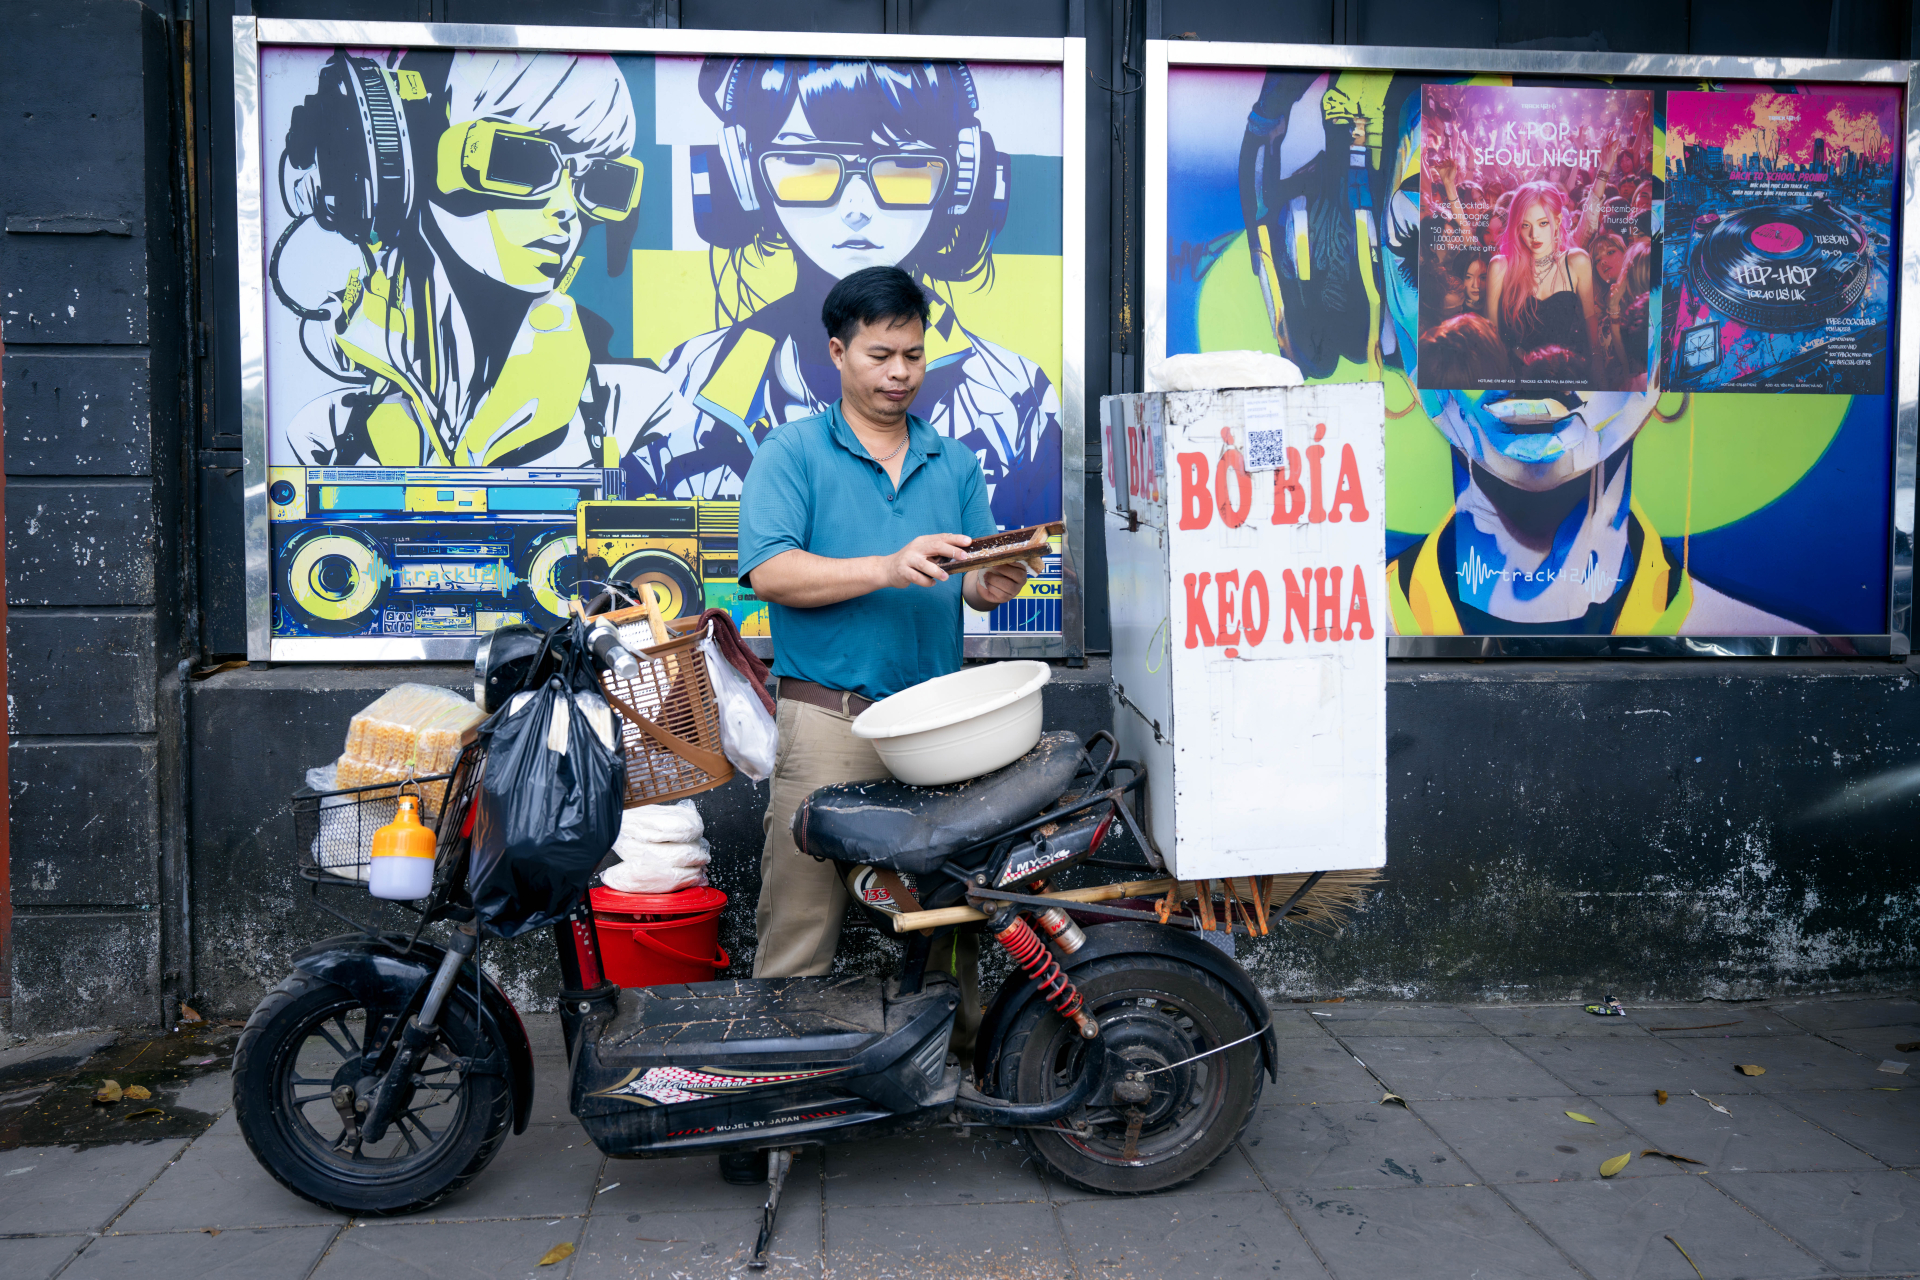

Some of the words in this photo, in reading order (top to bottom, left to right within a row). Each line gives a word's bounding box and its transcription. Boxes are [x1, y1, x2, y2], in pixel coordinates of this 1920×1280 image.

[1506, 121, 1570, 140] K-POP
[1474, 148, 1535, 166] SEOUL
[1543, 149, 1601, 167] NIGHT
[1729, 171, 1752, 181] BACK
[1753, 172, 1764, 181] TO
[1766, 172, 1797, 182] SCHOOL
[1799, 172, 1828, 182] PROMO
[1454, 201, 1490, 210] Cocktails
[1582, 203, 1593, 212] 04
[1596, 203, 1639, 214] September
[1441, 212, 1490, 221] Campagne
[1603, 214, 1639, 225] Thursday
[1814, 234, 1849, 246] TUESDAY
[1469, 243, 1482, 251] free
[1482, 244, 1496, 253] gifts
[1734, 264, 1817, 287] HIP-HOP
[1743, 288, 1762, 299] TOP
[1775, 287, 1790, 301] US
[1791, 289, 1806, 301] UK
[1271, 423, 1370, 525] BÍA
[1183, 568, 1270, 659] KẸO
[1282, 564, 1375, 645] NHA
[769, 1115, 800, 1125] JAPAN
